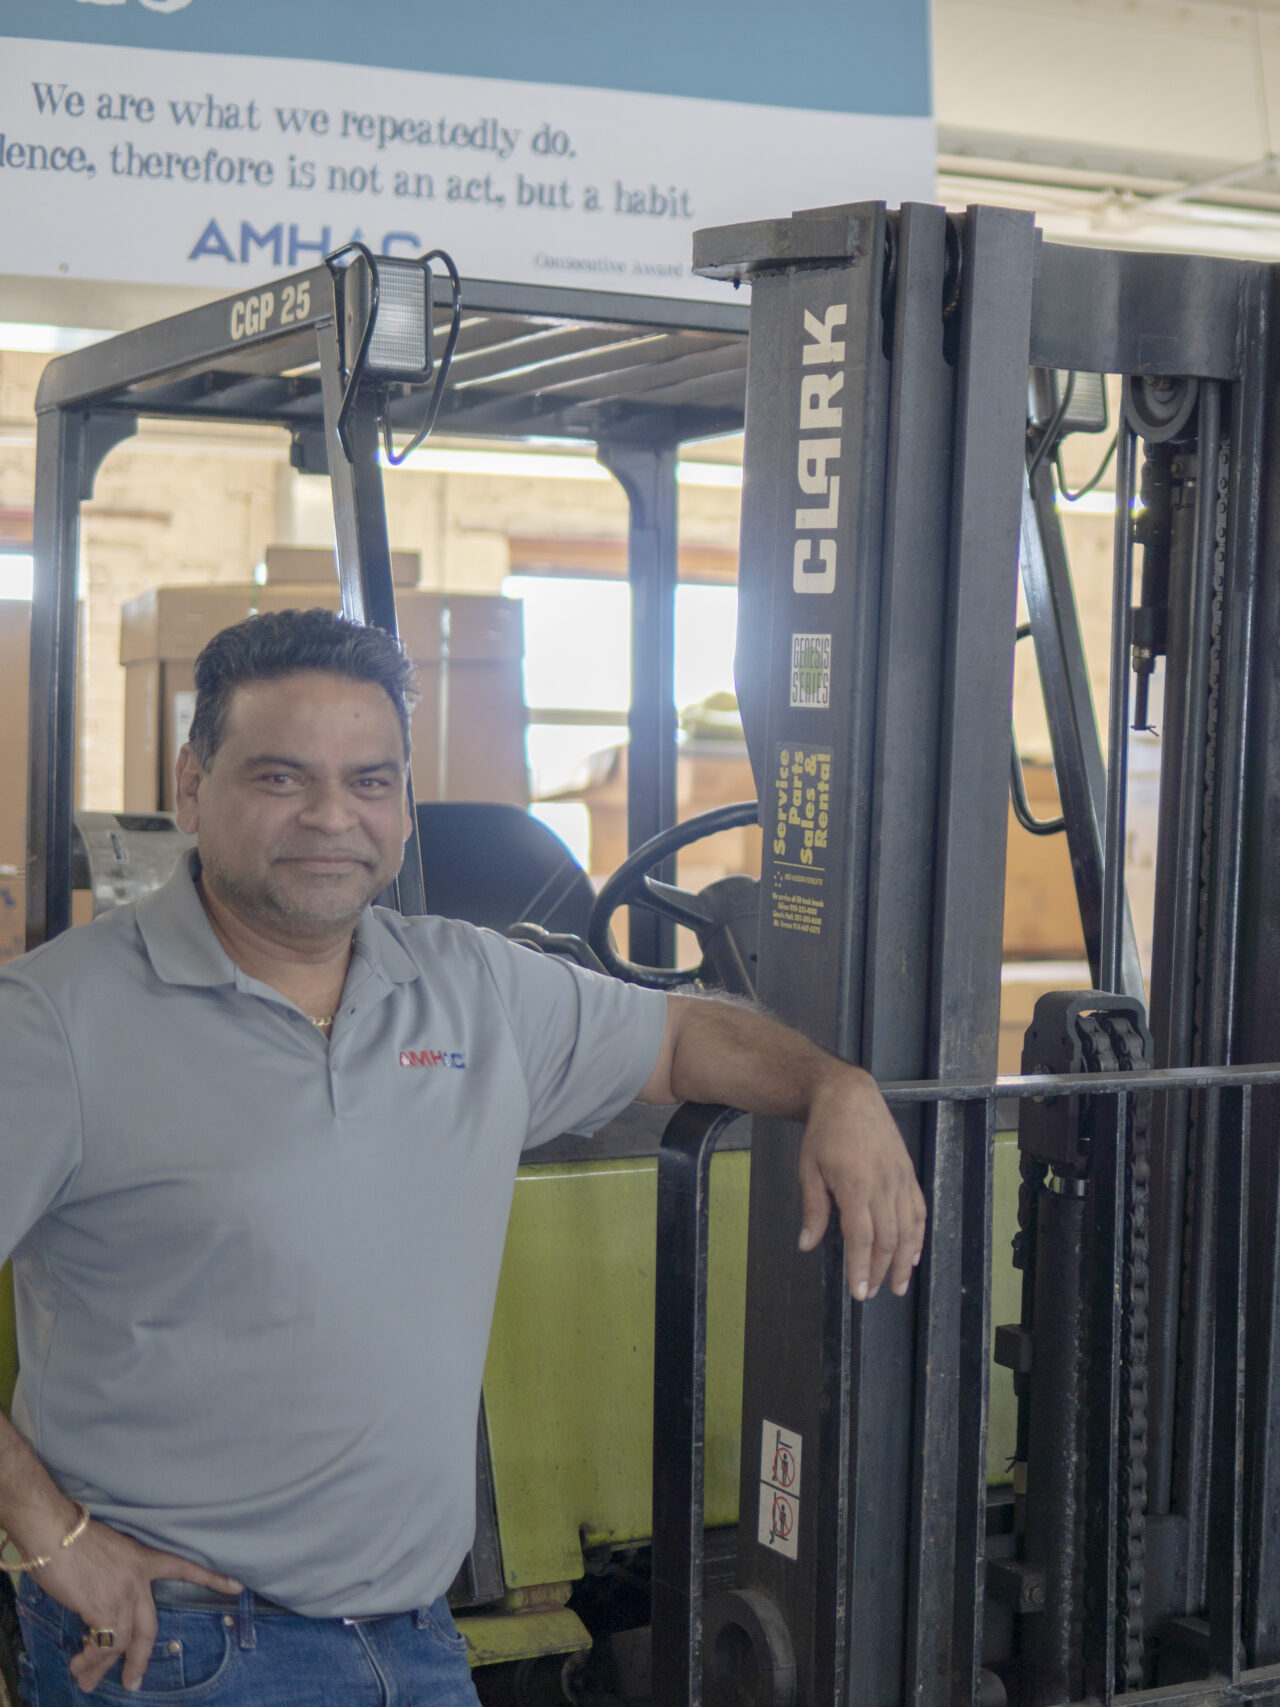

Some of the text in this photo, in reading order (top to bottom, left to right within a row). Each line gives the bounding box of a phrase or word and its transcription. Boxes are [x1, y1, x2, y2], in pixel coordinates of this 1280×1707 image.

[32, 82, 577, 159] We are what we repeatedly do.
[110, 142, 274, 186] therefore
[287, 155, 316, 190] is
[328, 162, 384, 195] not
[394, 171, 436, 200] an
[447, 173, 506, 206] act,
[517, 174, 574, 209] but
[584, 185, 603, 211] a
[614, 180, 694, 219] habit
[231, 280, 311, 341] CGP 25
[793, 304, 847, 594] CLARK
[792, 672, 828, 704] SERIES
[794, 638, 829, 669] GENESIS
[773, 750, 789, 856] Service
[789, 750, 803, 826] Parts
[800, 754, 817, 865] Sales &
[814, 753, 831, 848] Rental
[399, 1049, 466, 1069] AMHAC
